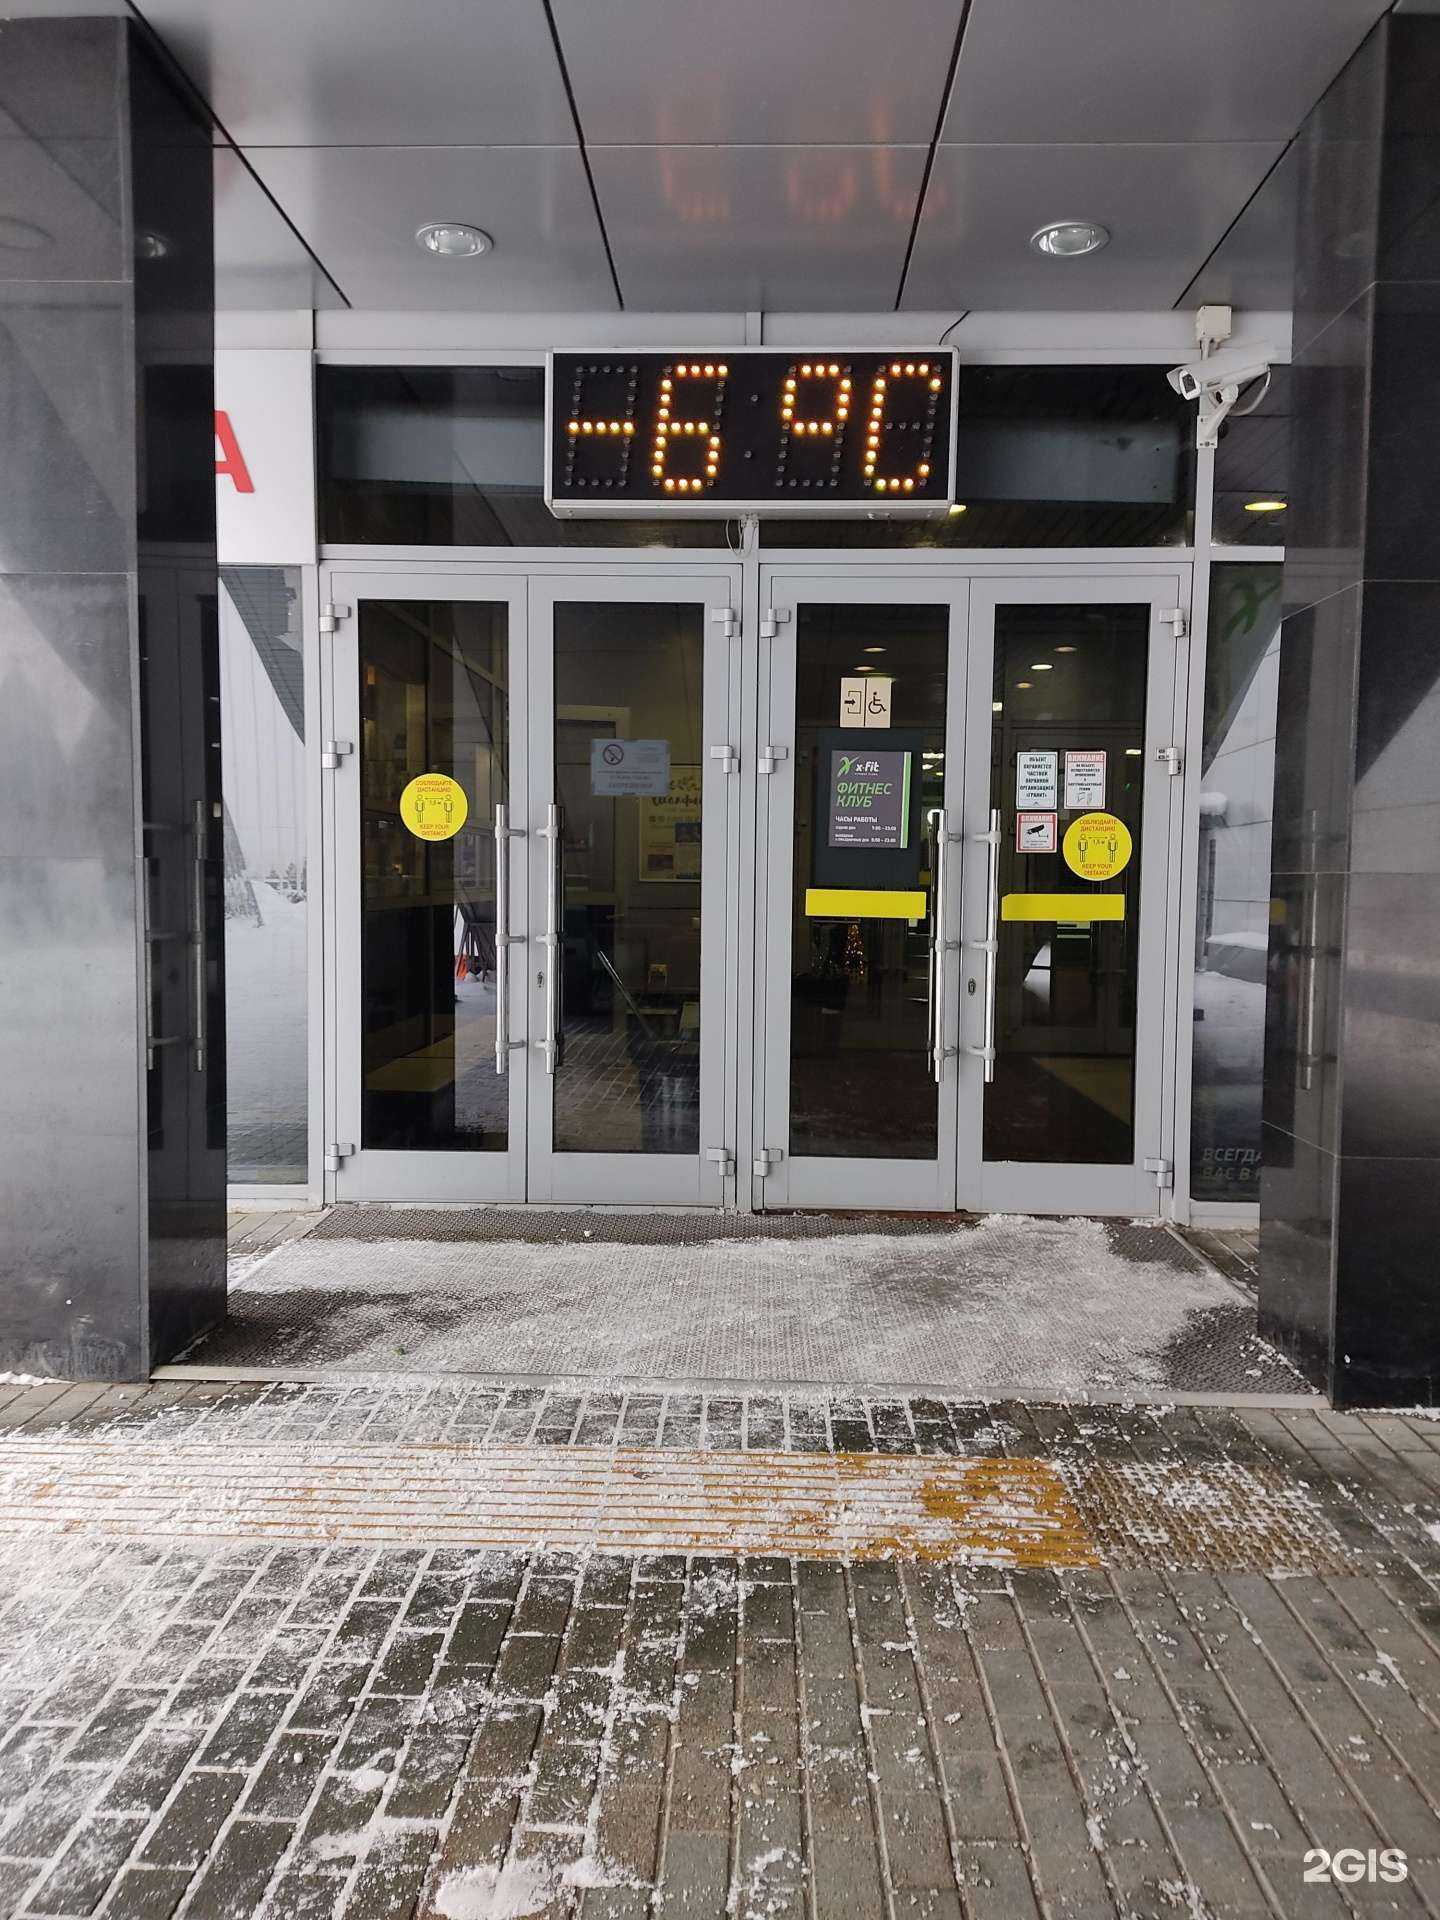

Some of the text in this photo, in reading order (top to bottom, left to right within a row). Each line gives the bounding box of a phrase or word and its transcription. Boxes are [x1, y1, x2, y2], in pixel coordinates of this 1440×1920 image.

[837, 782, 893, 795] ФИТНЕС
[836, 795, 873, 808] КЛУБ
[835, 815, 853, 823] ЧАСЫ
